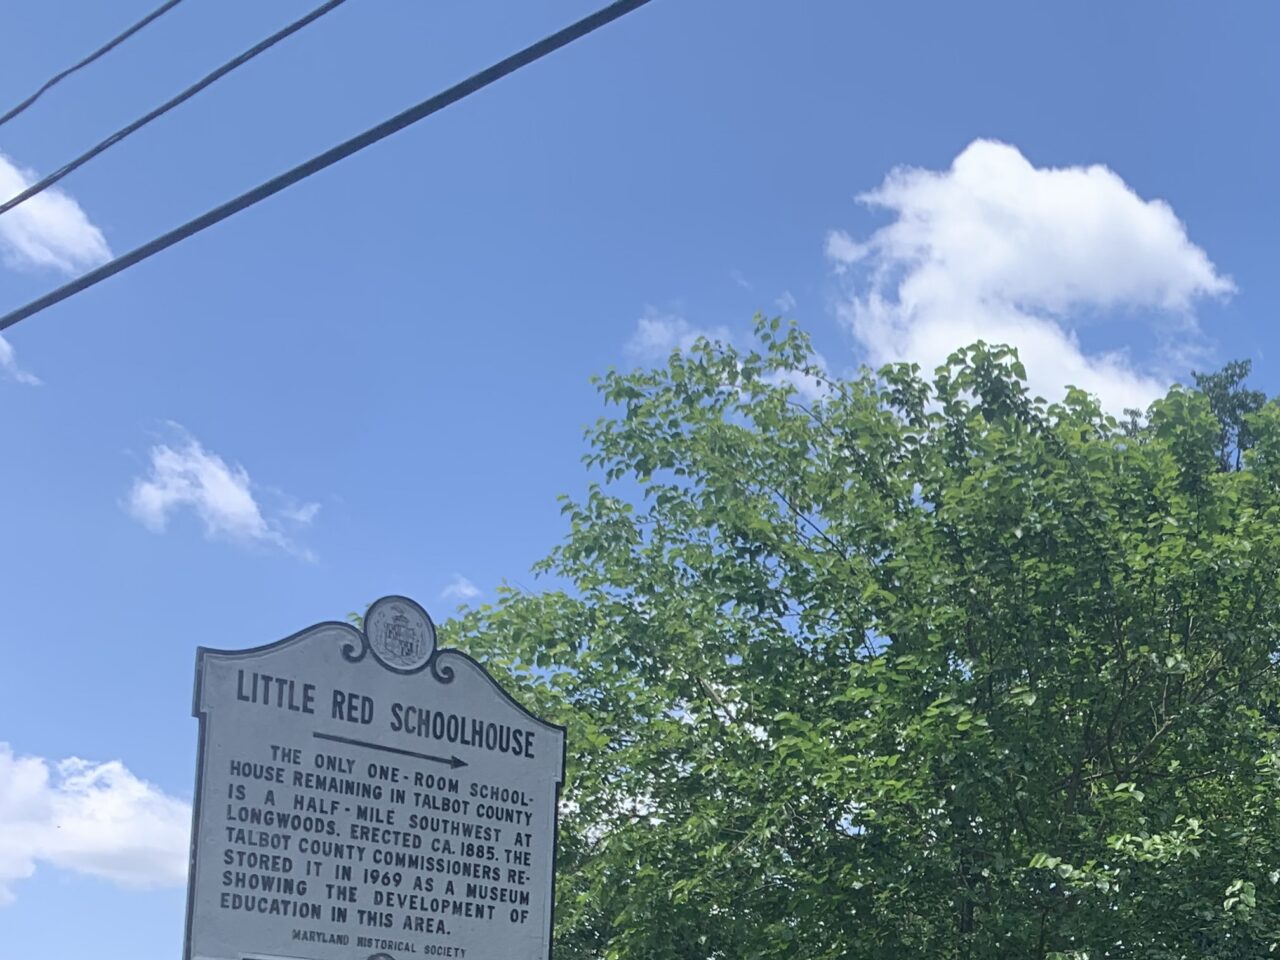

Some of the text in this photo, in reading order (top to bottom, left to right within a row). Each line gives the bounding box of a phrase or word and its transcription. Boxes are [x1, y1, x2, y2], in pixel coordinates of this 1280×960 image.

[237, 670, 535, 759] LITTLE RED SCHOOLHOUSE
[230, 760, 533, 826] HOUSE REMAINING IN TALBOT COUNTY
[270, 745, 302, 765] THE
[315, 754, 356, 774] ONLY
[470, 783, 534, 806] SCHOOL-
[226, 804, 531, 866] LONGWOODS. ERECTED CA. 1885. THE
[228, 784, 246, 800] IS
[264, 790, 275, 806] A
[408, 814, 501, 842] SOUTHWEST
[514, 832, 532, 847] AT
[223, 849, 530, 906] STORED IT IN 1969 AS A MUSEUM
[226, 827, 530, 885] TALBOT COUNTY COMMISSIONERS RE-
[220, 892, 451, 935] EDUCATION IN THIS AREA.
[222, 870, 529, 924] SHOWING THE DEVELOPMENT OF
[292, 929, 467, 958] MARYLAND HISTORICAL SOCIETY
